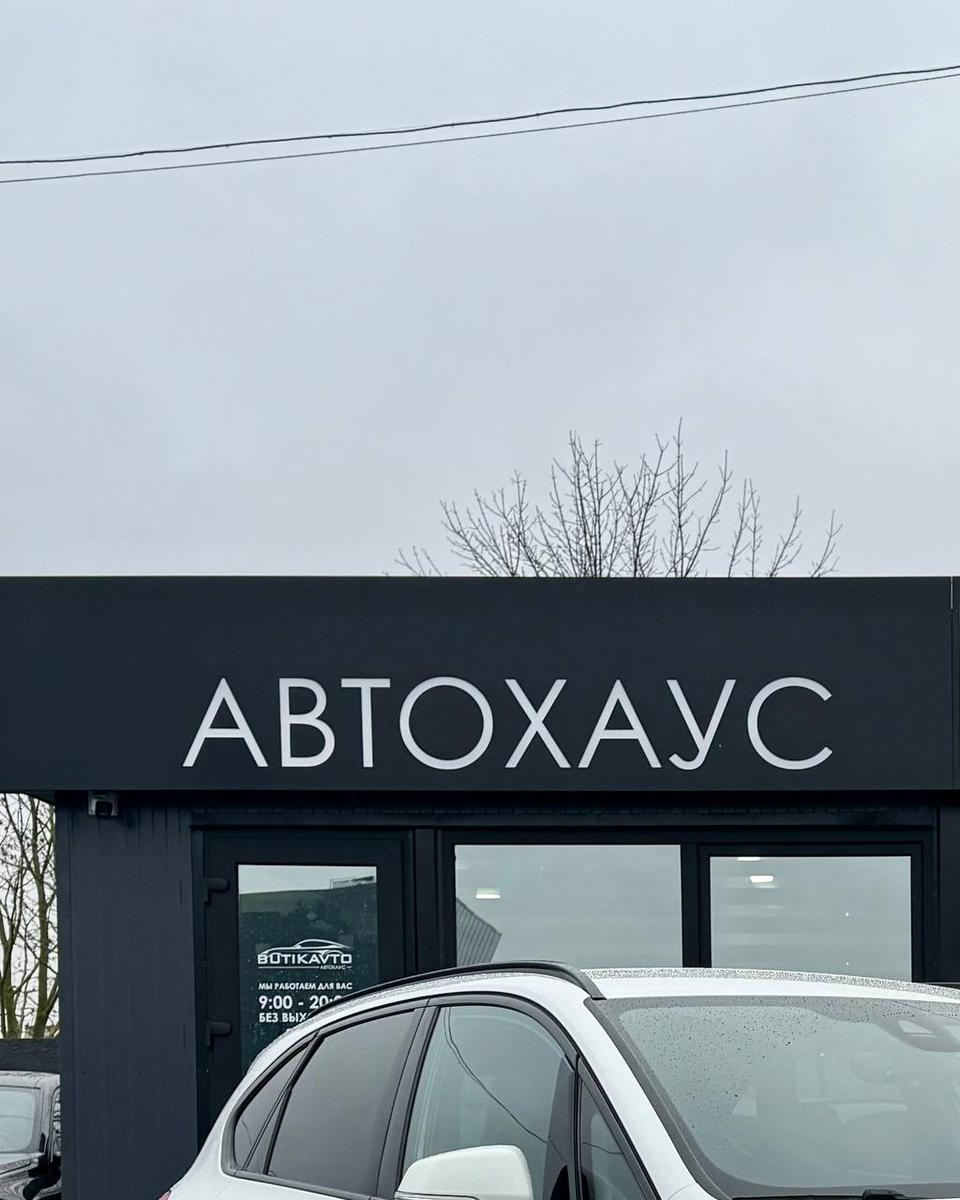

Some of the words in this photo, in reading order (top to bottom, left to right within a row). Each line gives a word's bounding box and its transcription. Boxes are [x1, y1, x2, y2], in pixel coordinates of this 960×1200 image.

[181, 675, 834, 772] АВТОХАУС
[257, 954, 352, 964] BUTIKAVTO
[259, 982, 273, 990] МЫ
[274, 982, 317, 990] РАБОТАЕМ
[317, 982, 335, 990] ДЛЯ
[336, 982, 353, 990] ВАС
[259, 995, 293, 1009] 9:00
[259, 1012, 278, 1022] БЕЗ
